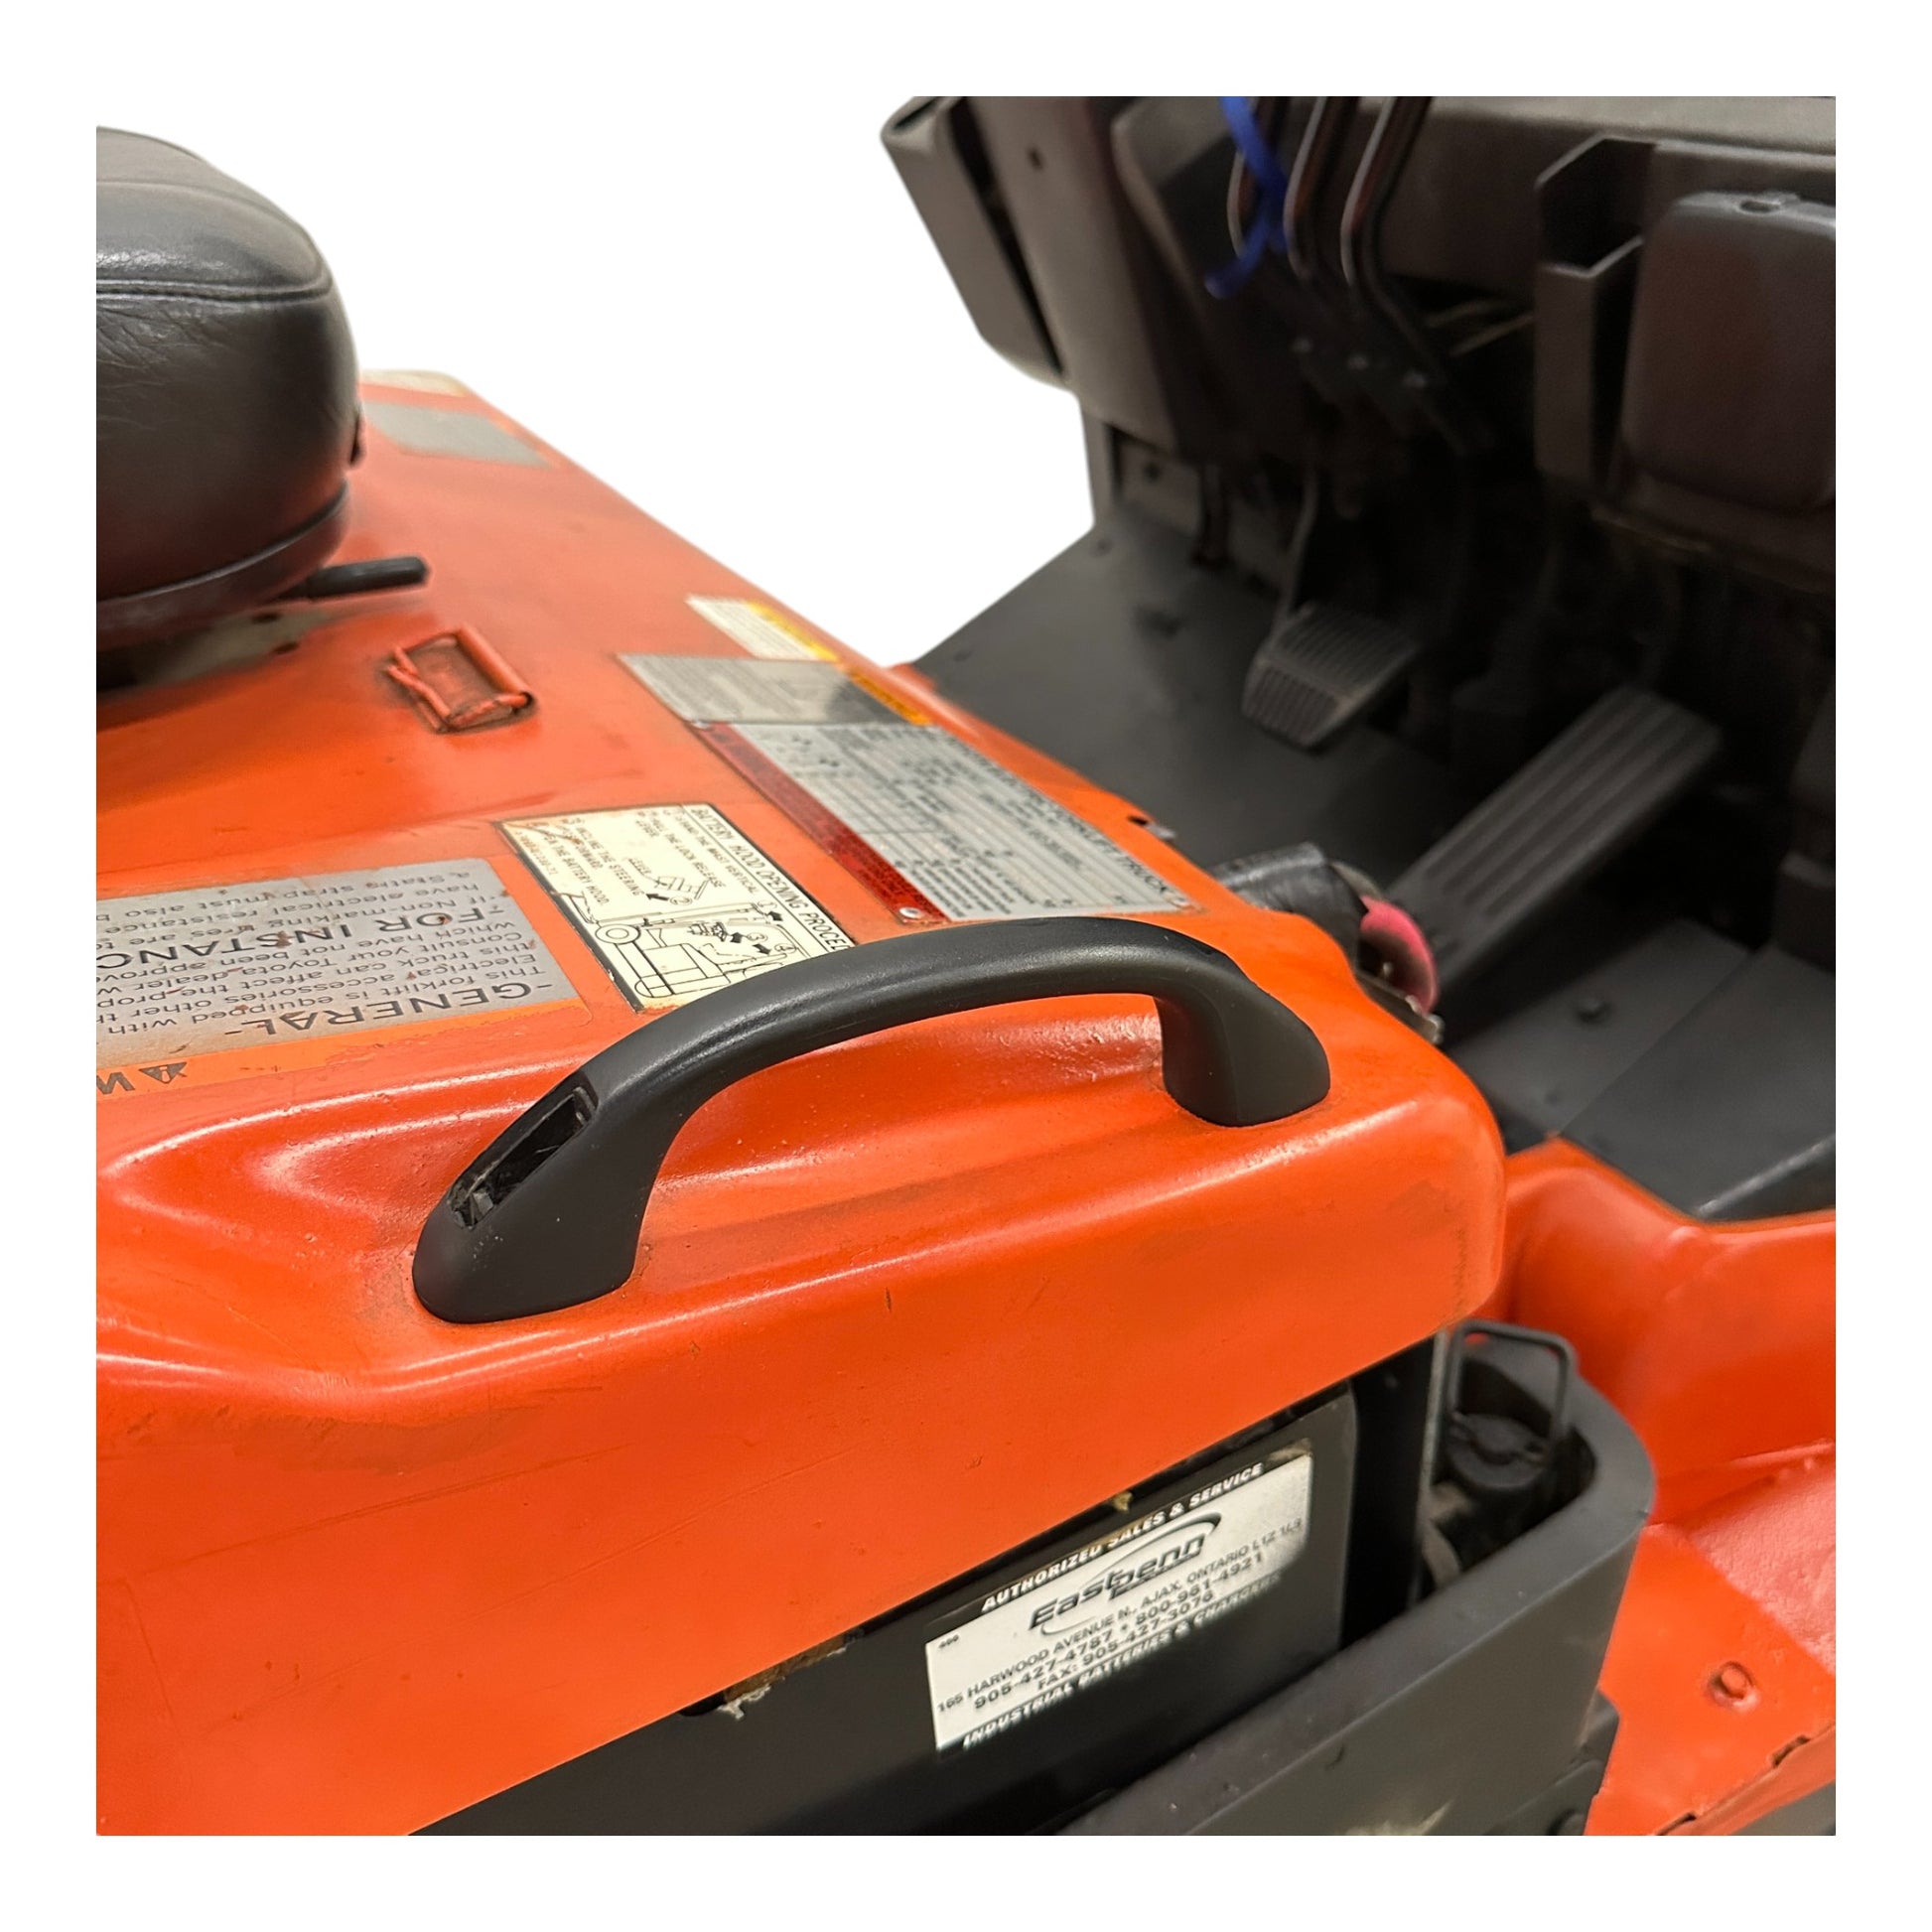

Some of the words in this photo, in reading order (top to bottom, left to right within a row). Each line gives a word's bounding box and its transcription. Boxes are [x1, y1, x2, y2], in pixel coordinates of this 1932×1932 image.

[732, 844, 765, 869] HOOD
[756, 869, 809, 909] OPENING
[284, 884, 353, 899] strap
[415, 883, 479, 896] have
[200, 893, 267, 909] must
[273, 893, 403, 915] electrical
[125, 905, 186, 917] also
[268, 898, 456, 927] Non-marking
[105, 910, 258, 933] resistance
[435, 921, 514, 937] which
[96, 924, 351, 969] INSTANC
[130, 934, 175, 944] are
[357, 934, 424, 947] have
[419, 932, 522, 951] Consult
[302, 944, 345, 956] not
[349, 946, 409, 961] your
[480, 943, 529, 955] this
[220, 951, 289, 966] been
[243, 958, 338, 974] Toyota
[400, 952, 468, 968] truck
[406, 954, 536, 979] Electrica
[337, 963, 386, 975] can
[485, 966, 545, 980] This
[138, 971, 228, 990] dealer
[242, 971, 323, 989] affect
[381, 976, 475, 996] forklift
[181, 984, 228, 996] the
[225, 975, 395, 1003] accessories
[345, 991, 367, 1000] is
[133, 1000, 211, 1017] other
[192, 996, 334, 1024] equipped
[109, 1019, 178, 1034] with
[981, 1544, 1102, 1613] AUTHORIZED
[1107, 1511, 1166, 1550] SALES
[1170, 1502, 1184, 1520] &
[1189, 1461, 1264, 1508] SERVICE
[937, 1692, 964, 1713] 165
[968, 1648, 1049, 1699] HARWOOD
[1053, 1616, 1113, 1651] AVENUE
[1186, 1545, 1249, 1583] ONTARIO
[973, 1630, 1114, 1710] 905-427-4787
[1037, 1665, 1078, 1690] FAX:
[963, 1683, 1074, 1749] INDUSTRIAL
